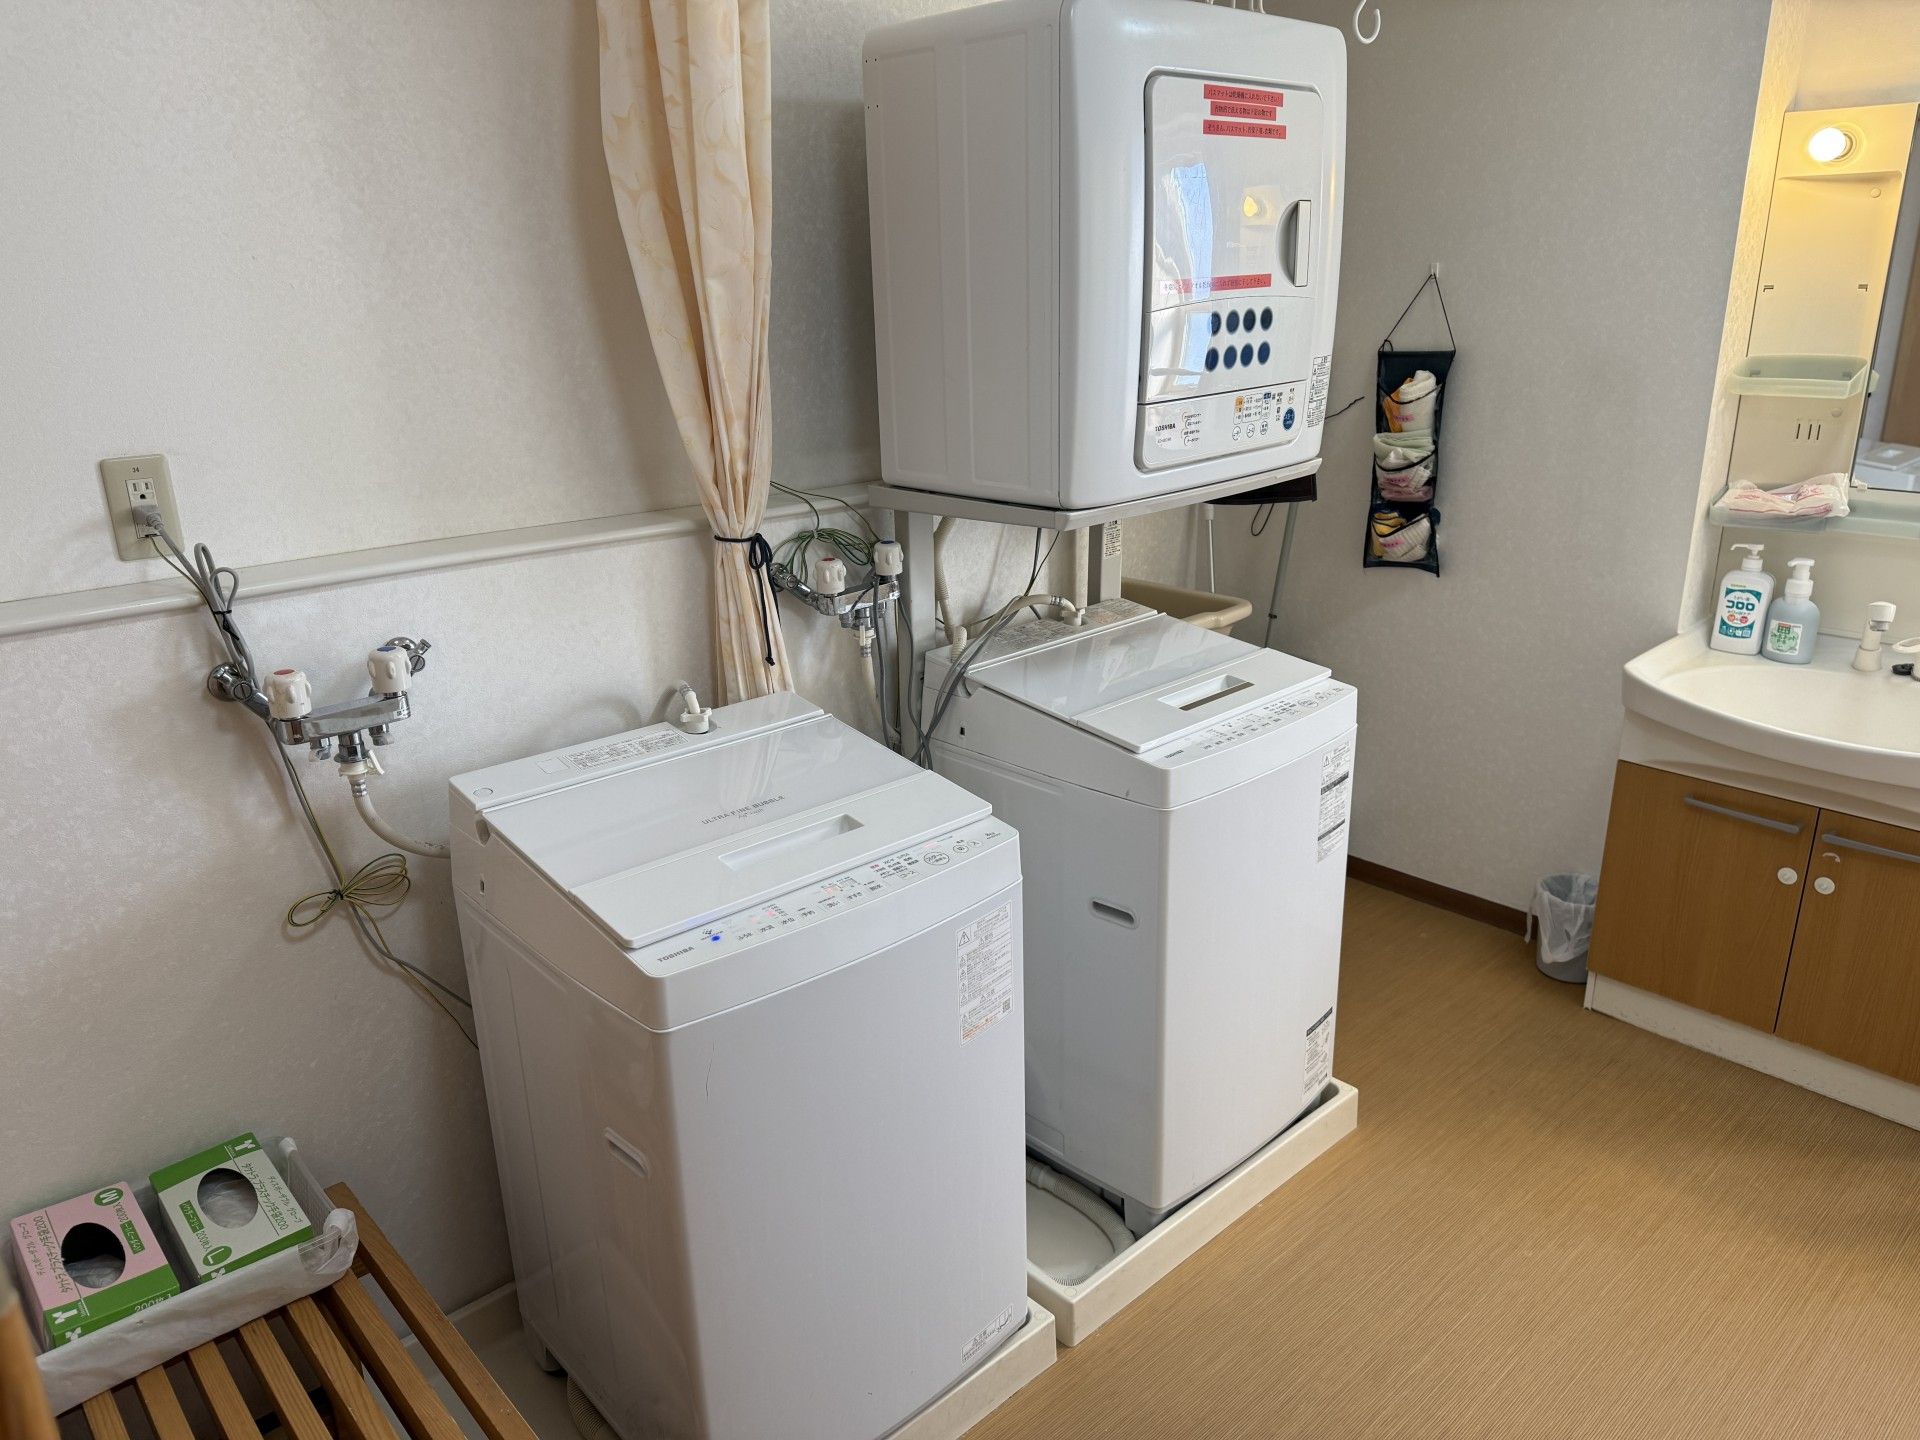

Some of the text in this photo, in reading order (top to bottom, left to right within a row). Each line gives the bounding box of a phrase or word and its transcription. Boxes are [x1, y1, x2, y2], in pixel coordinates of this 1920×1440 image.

[1154, 423, 1176, 432] TOSHIBA
[1726, 600, 1755, 611] コロロ
[701, 812, 730, 825] ULTRA
[730, 805, 752, 816] FINE
[751, 795, 785, 809] BUBBLE
[657, 945, 695, 963] TOSHIBA
[99, 1188, 120, 1204] M
[207, 1247, 225, 1264] L
